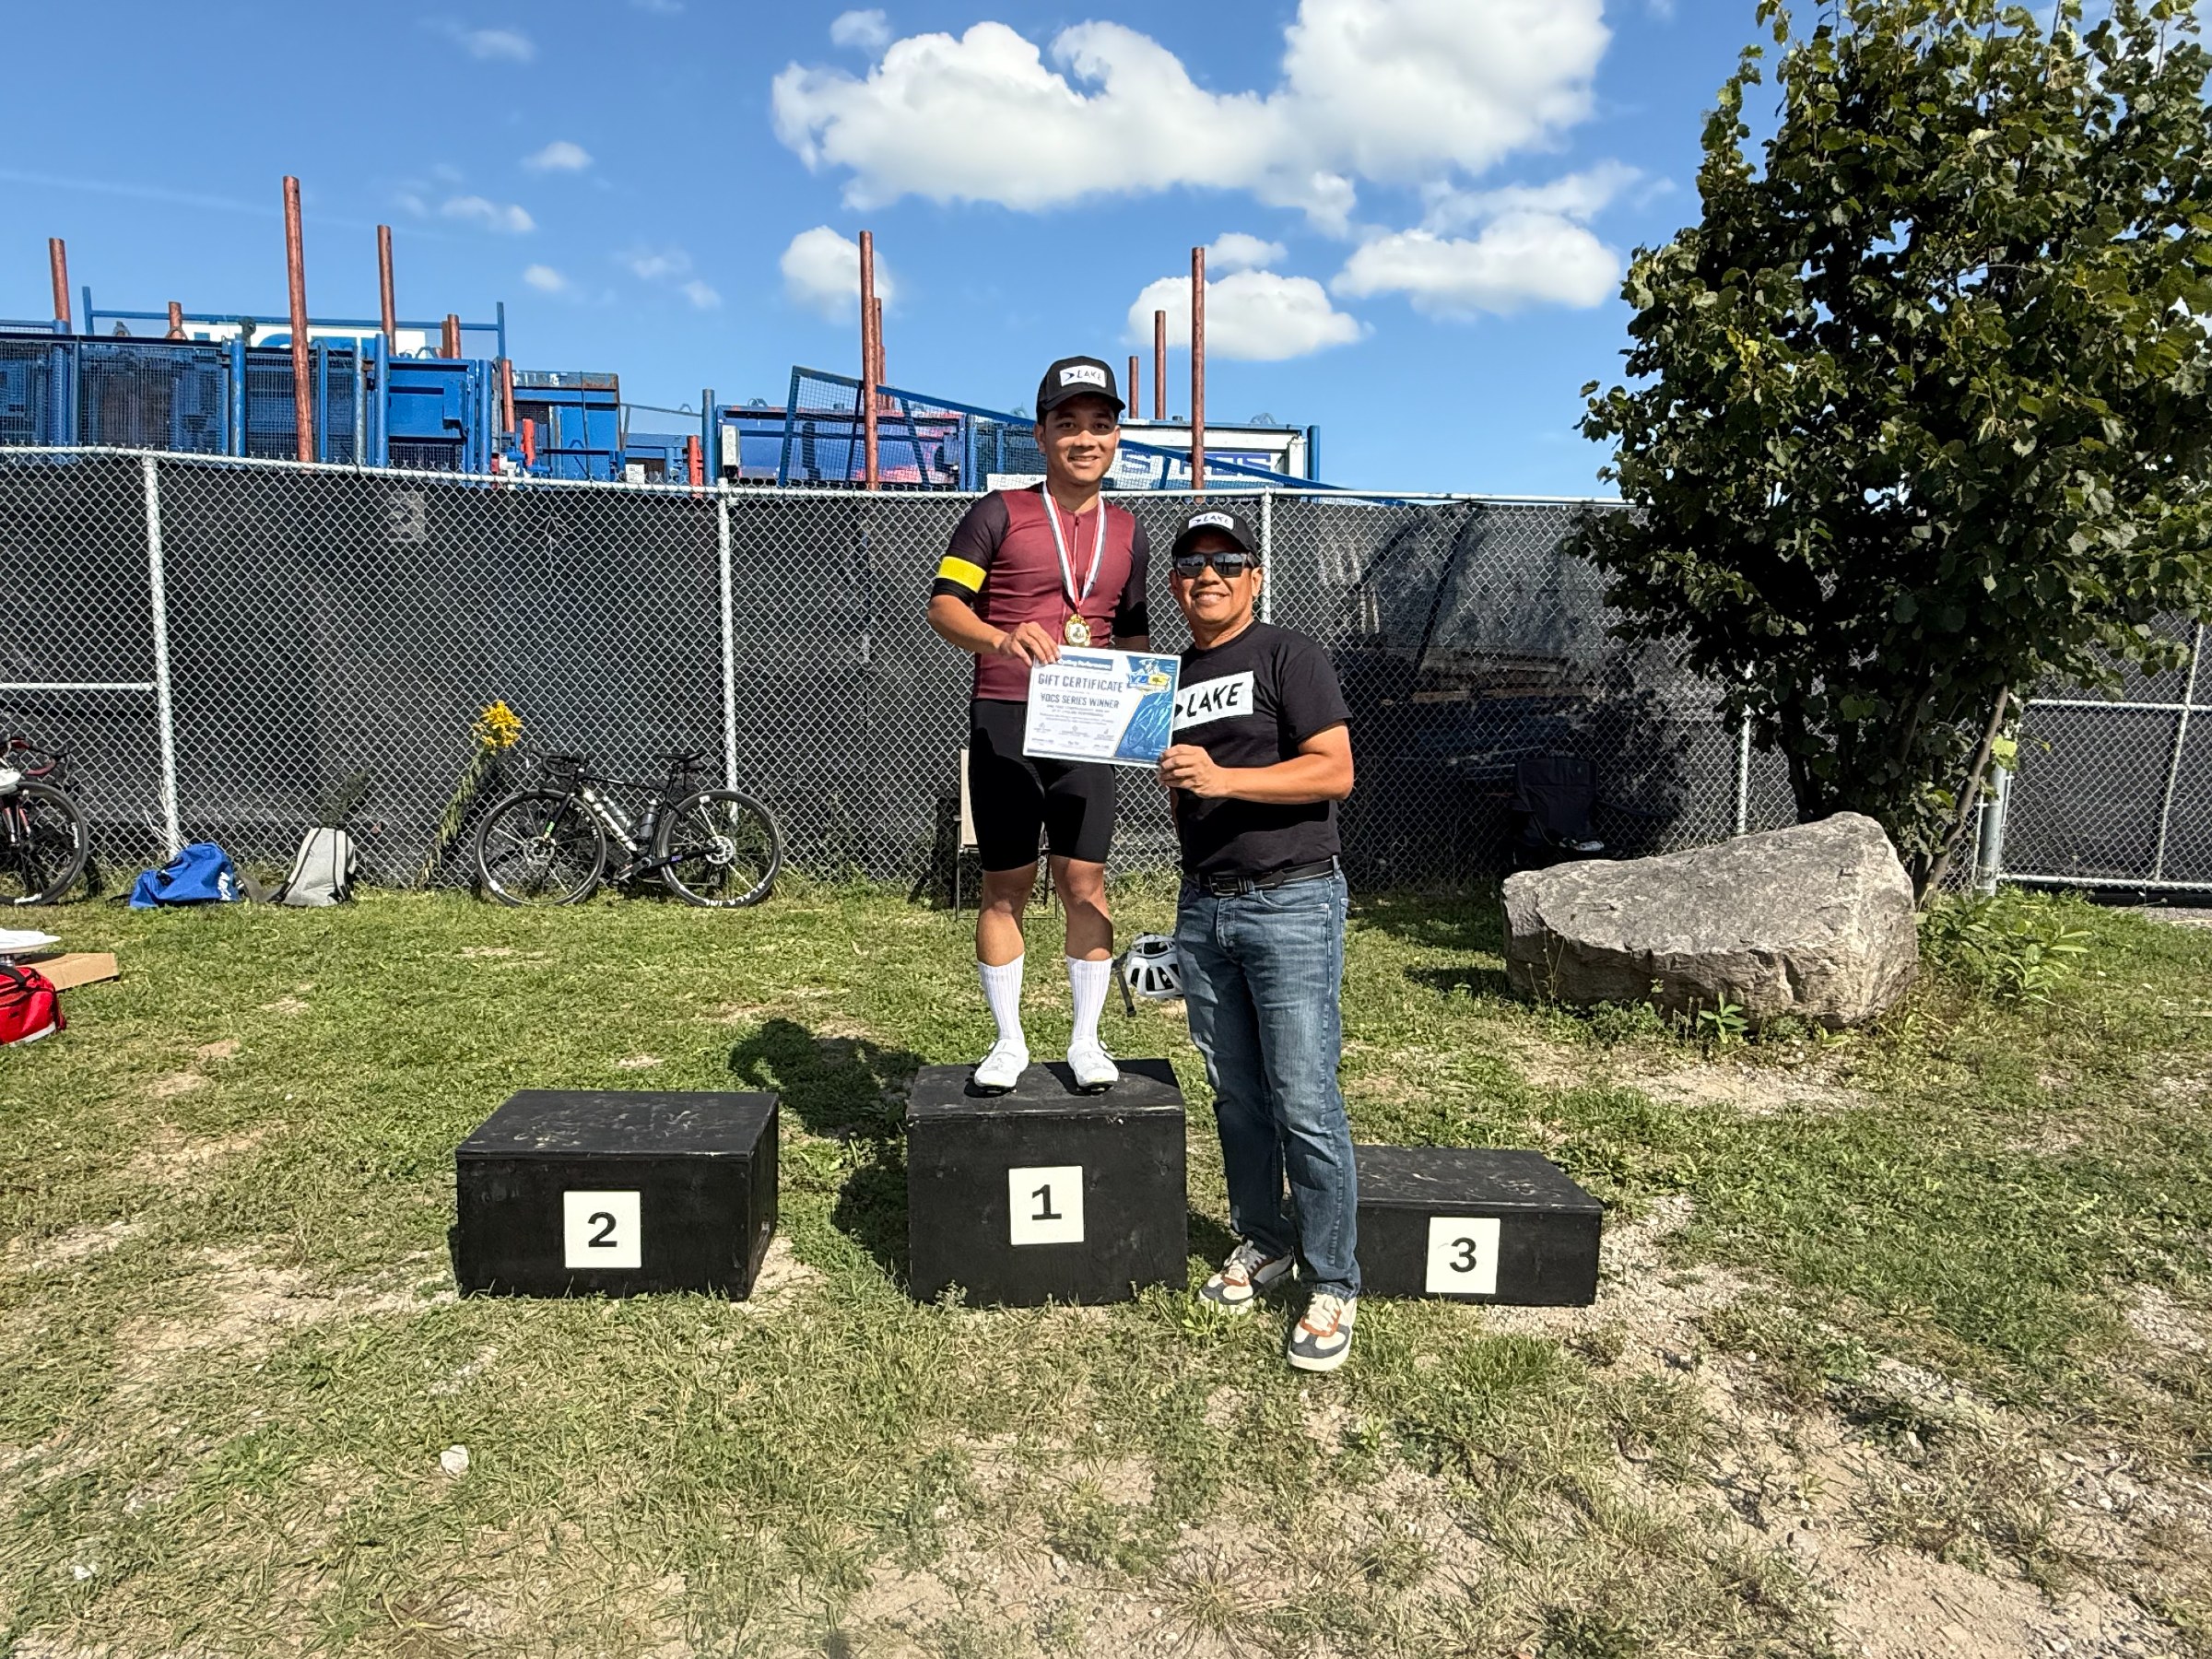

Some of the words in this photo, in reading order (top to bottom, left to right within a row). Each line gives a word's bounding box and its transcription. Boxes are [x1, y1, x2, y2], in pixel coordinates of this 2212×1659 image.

[1077, 369, 1102, 382] LAKE
[1203, 515, 1229, 524] LAKE
[1038, 673, 1060, 686] GIFT
[1062, 676, 1124, 692] CERTIFICATE
[1062, 694, 1088, 706] SERIES
[1089, 698, 1120, 709] WINNER
[1186, 682, 1244, 718] LAKE
[1031, 1183, 1062, 1221] 1
[587, 1211, 618, 1248] 2
[1449, 1237, 1477, 1273] 3
